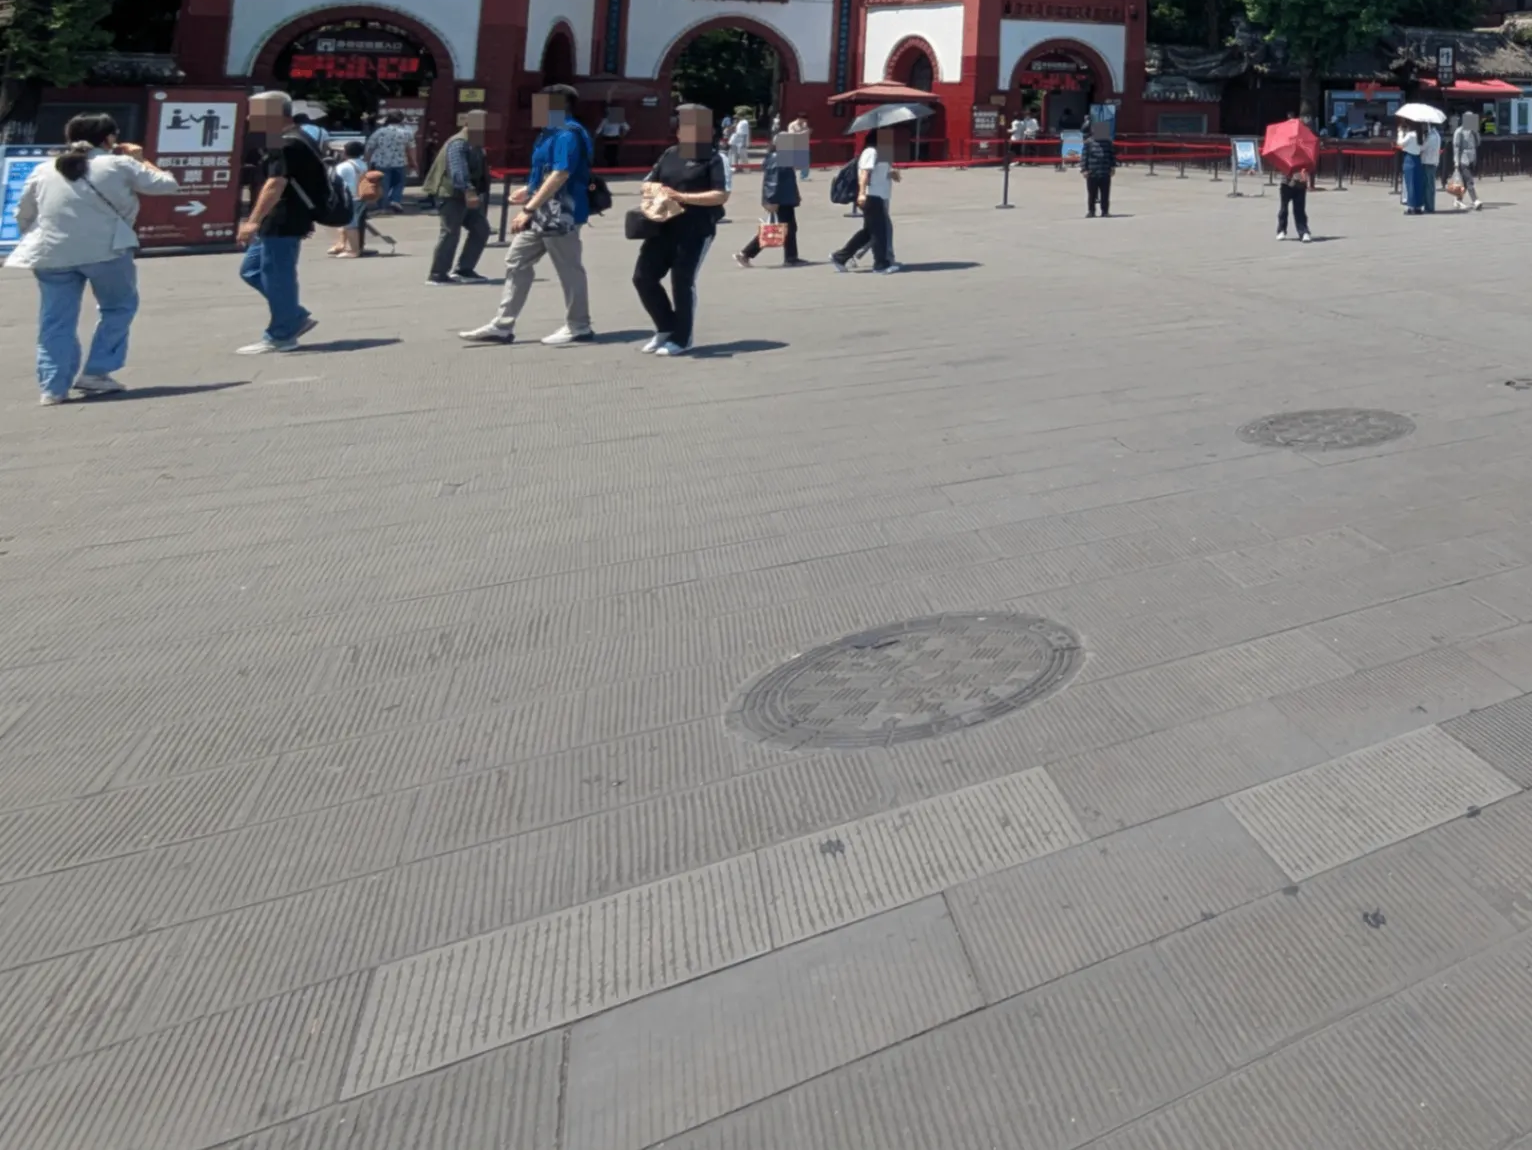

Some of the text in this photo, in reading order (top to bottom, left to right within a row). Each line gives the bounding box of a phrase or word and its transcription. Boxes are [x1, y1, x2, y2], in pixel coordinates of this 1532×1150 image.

[157, 156, 231, 167] 都江堰景区
[183, 169, 231, 183] 票口
